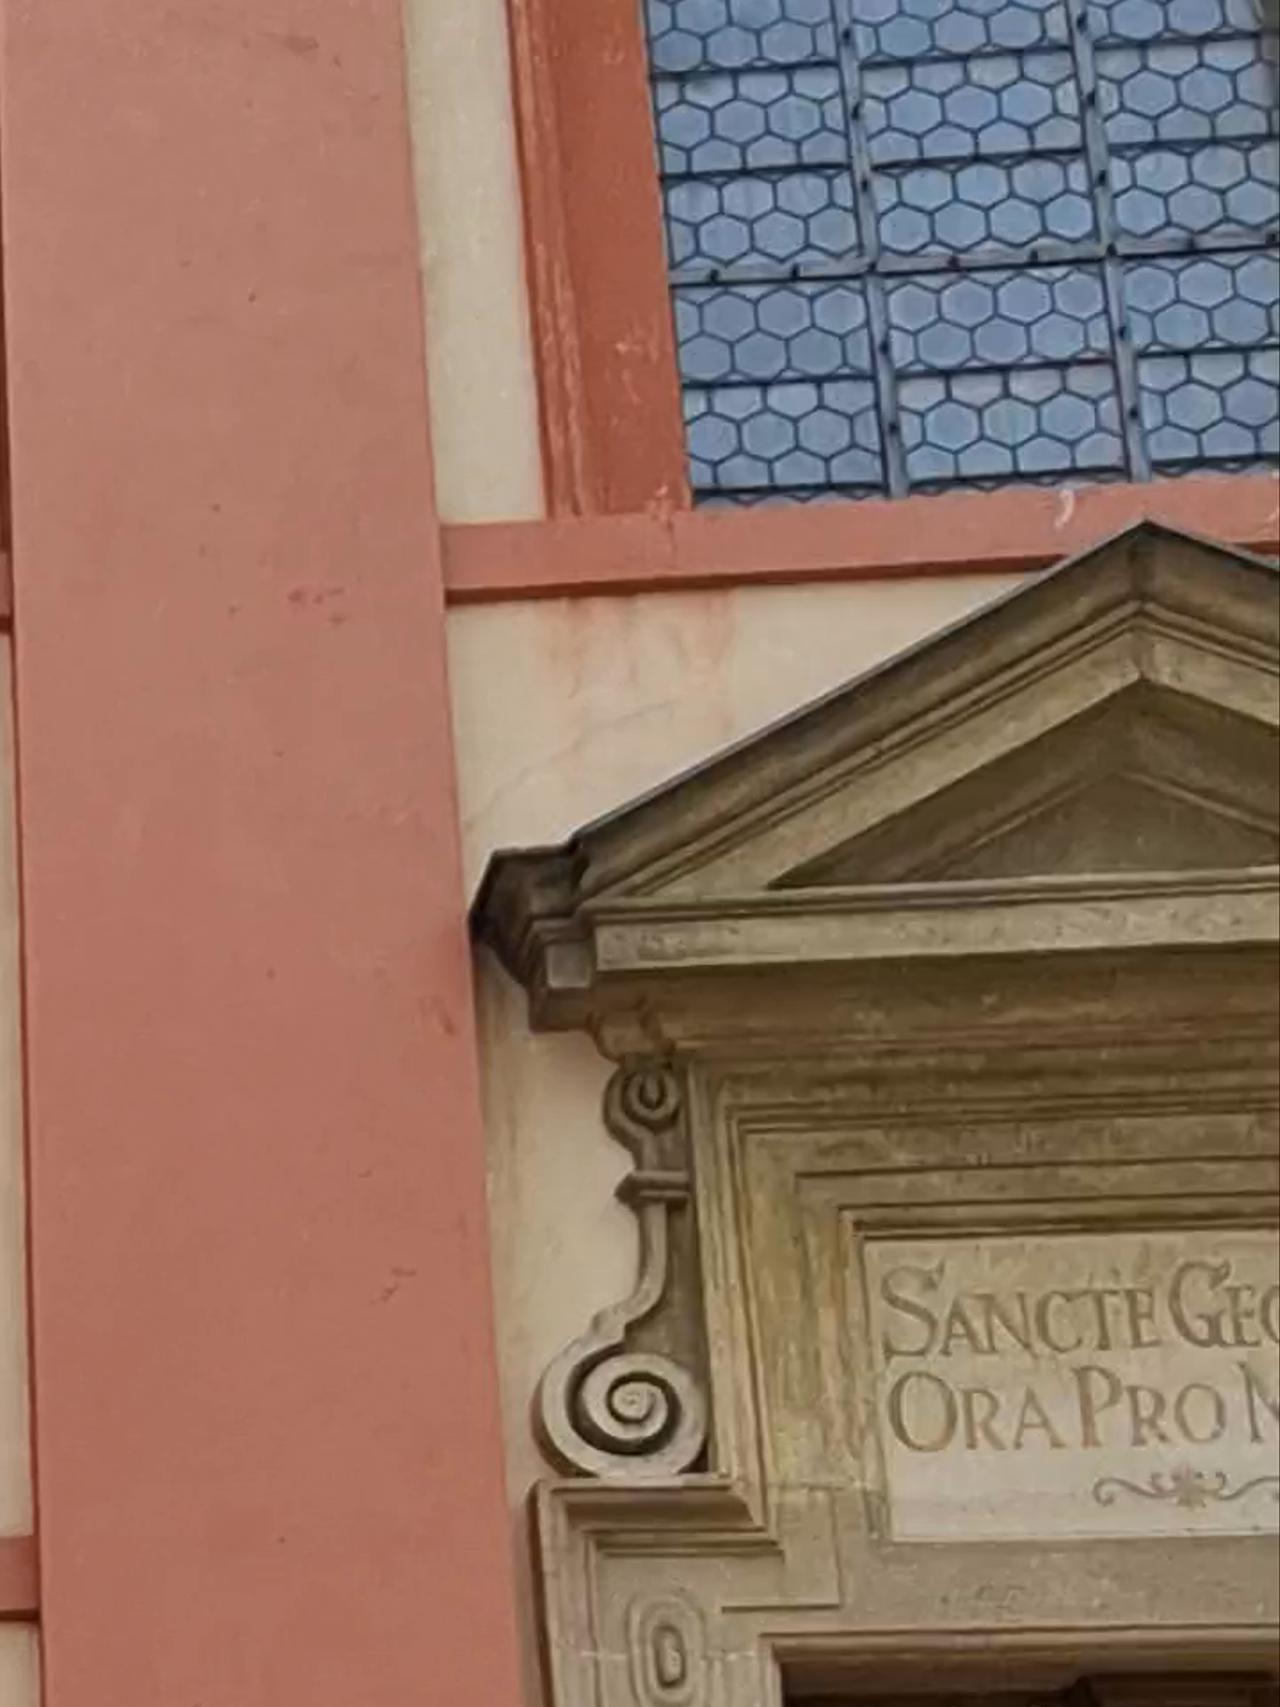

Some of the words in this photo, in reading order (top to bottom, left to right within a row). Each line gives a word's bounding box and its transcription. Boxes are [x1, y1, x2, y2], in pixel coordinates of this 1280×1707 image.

[880, 1264, 1161, 1360] SANCTE
[888, 1371, 1067, 1452] ORA
[1070, 1364, 1227, 1449] PRO
